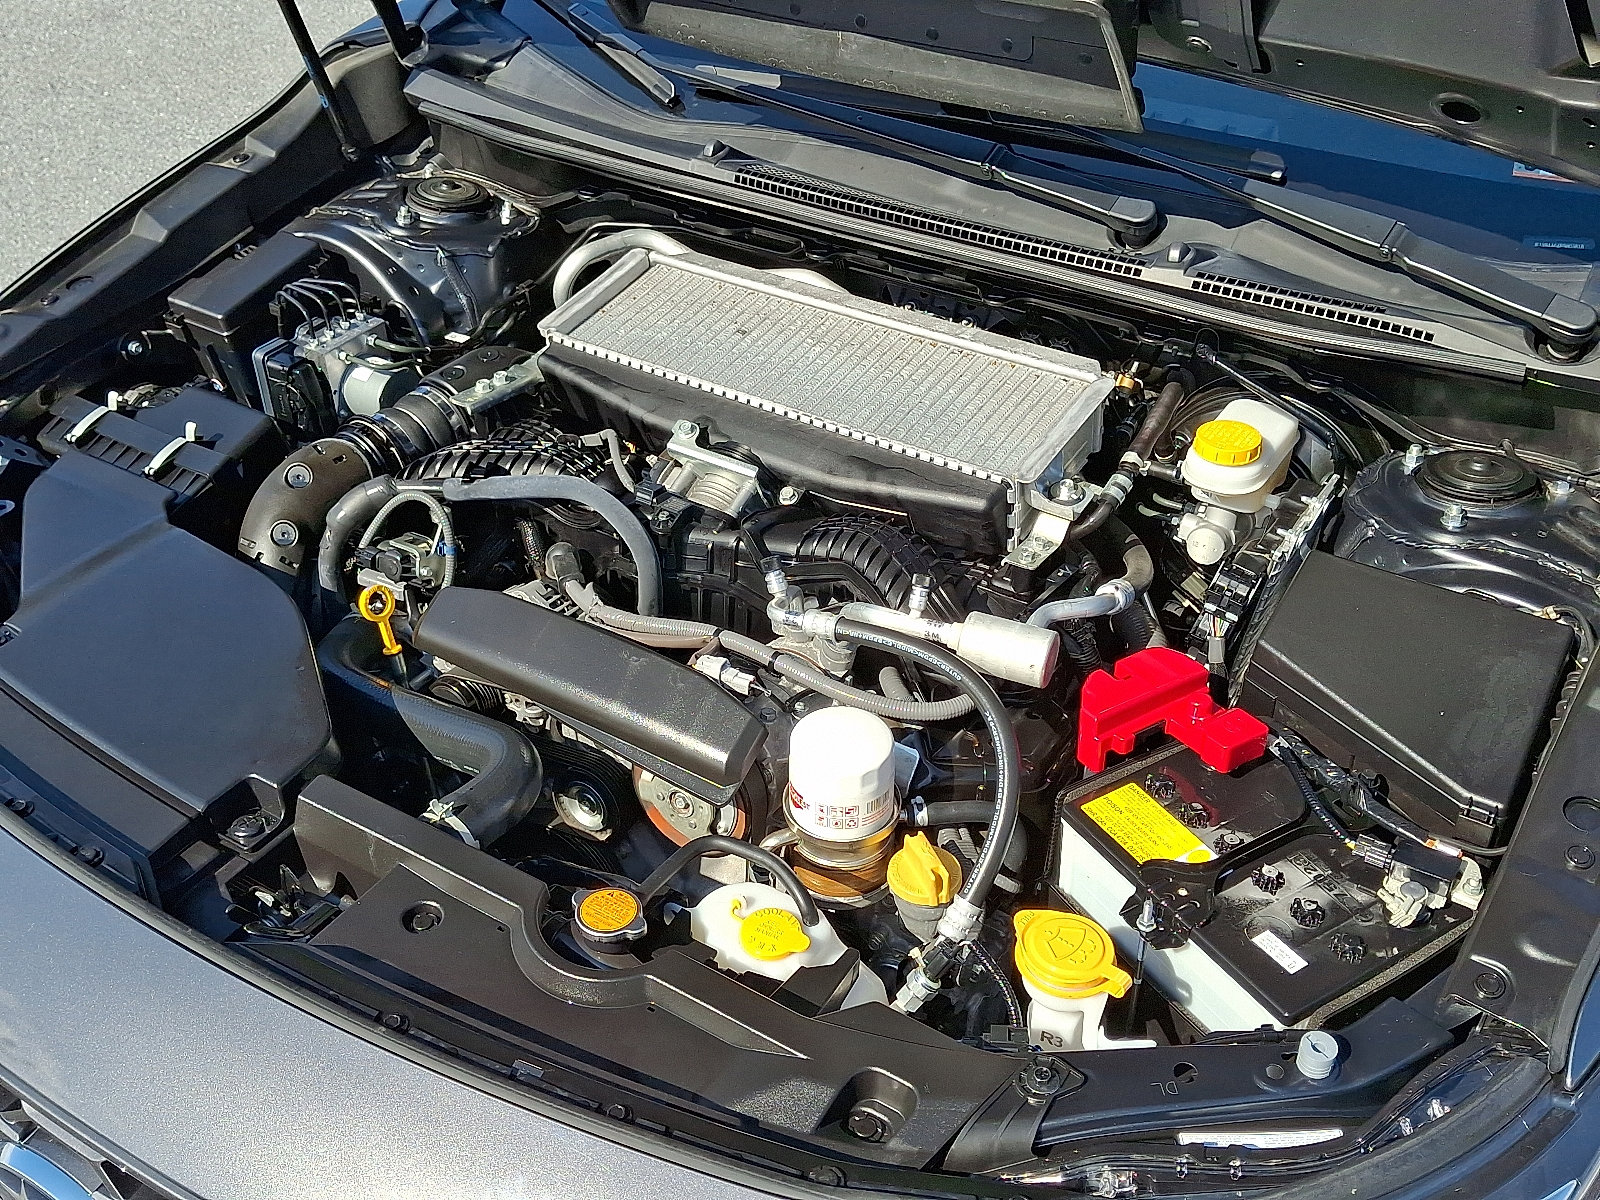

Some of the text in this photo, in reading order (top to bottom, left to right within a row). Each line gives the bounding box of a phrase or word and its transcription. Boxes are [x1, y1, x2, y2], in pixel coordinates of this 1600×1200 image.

[1127, 784, 1151, 803] DANGER
[1103, 796, 1124, 815] POISON
[1040, 1030, 1063, 1048] R3
